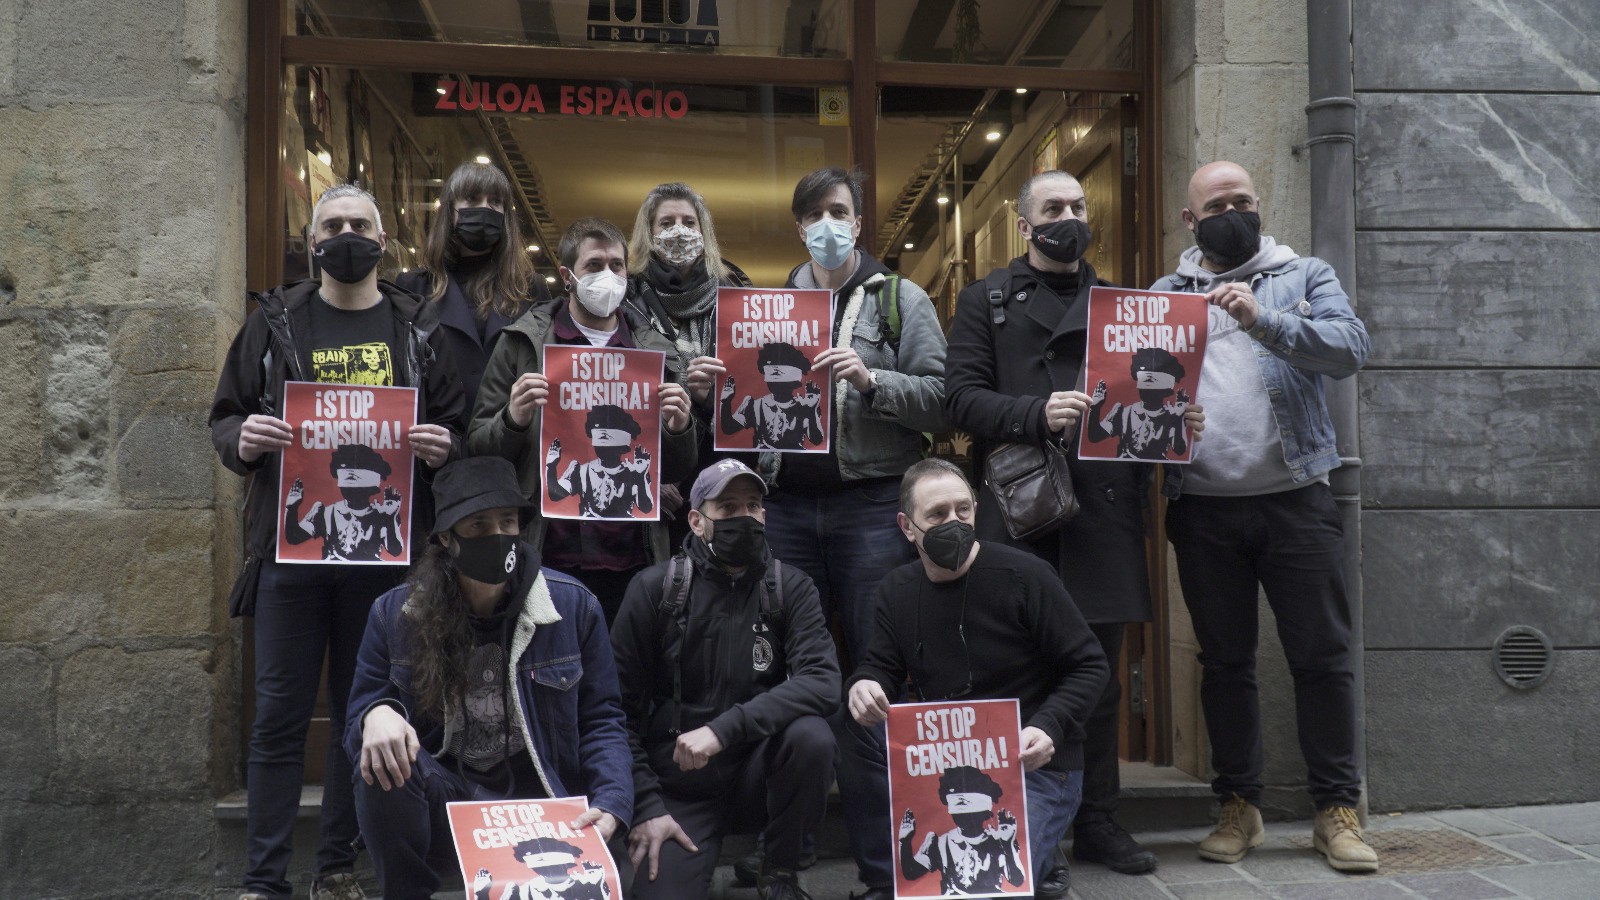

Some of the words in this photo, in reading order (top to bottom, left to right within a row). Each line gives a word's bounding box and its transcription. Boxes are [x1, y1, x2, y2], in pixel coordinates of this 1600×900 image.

[591, 26, 715, 45] IRUDIA
[435, 80, 545, 113] ZULOA
[560, 85, 689, 119] ESPACIO
[743, 293, 795, 320] ¡STOP
[1116, 295, 1170, 324] ¡STOP
[731, 320, 819, 348] CENSURA!
[1103, 324, 1196, 353] CENSURA!
[571, 352, 626, 380] ¡STOP
[315, 390, 375, 419] ¡STOP
[560, 381, 650, 410] CENSURA!
[301, 420, 401, 450] CENSURA!
[915, 706, 976, 742] ¡STOP
[905, 736, 1009, 777] CENSURA!
[480, 803, 545, 828] ¡STOP
